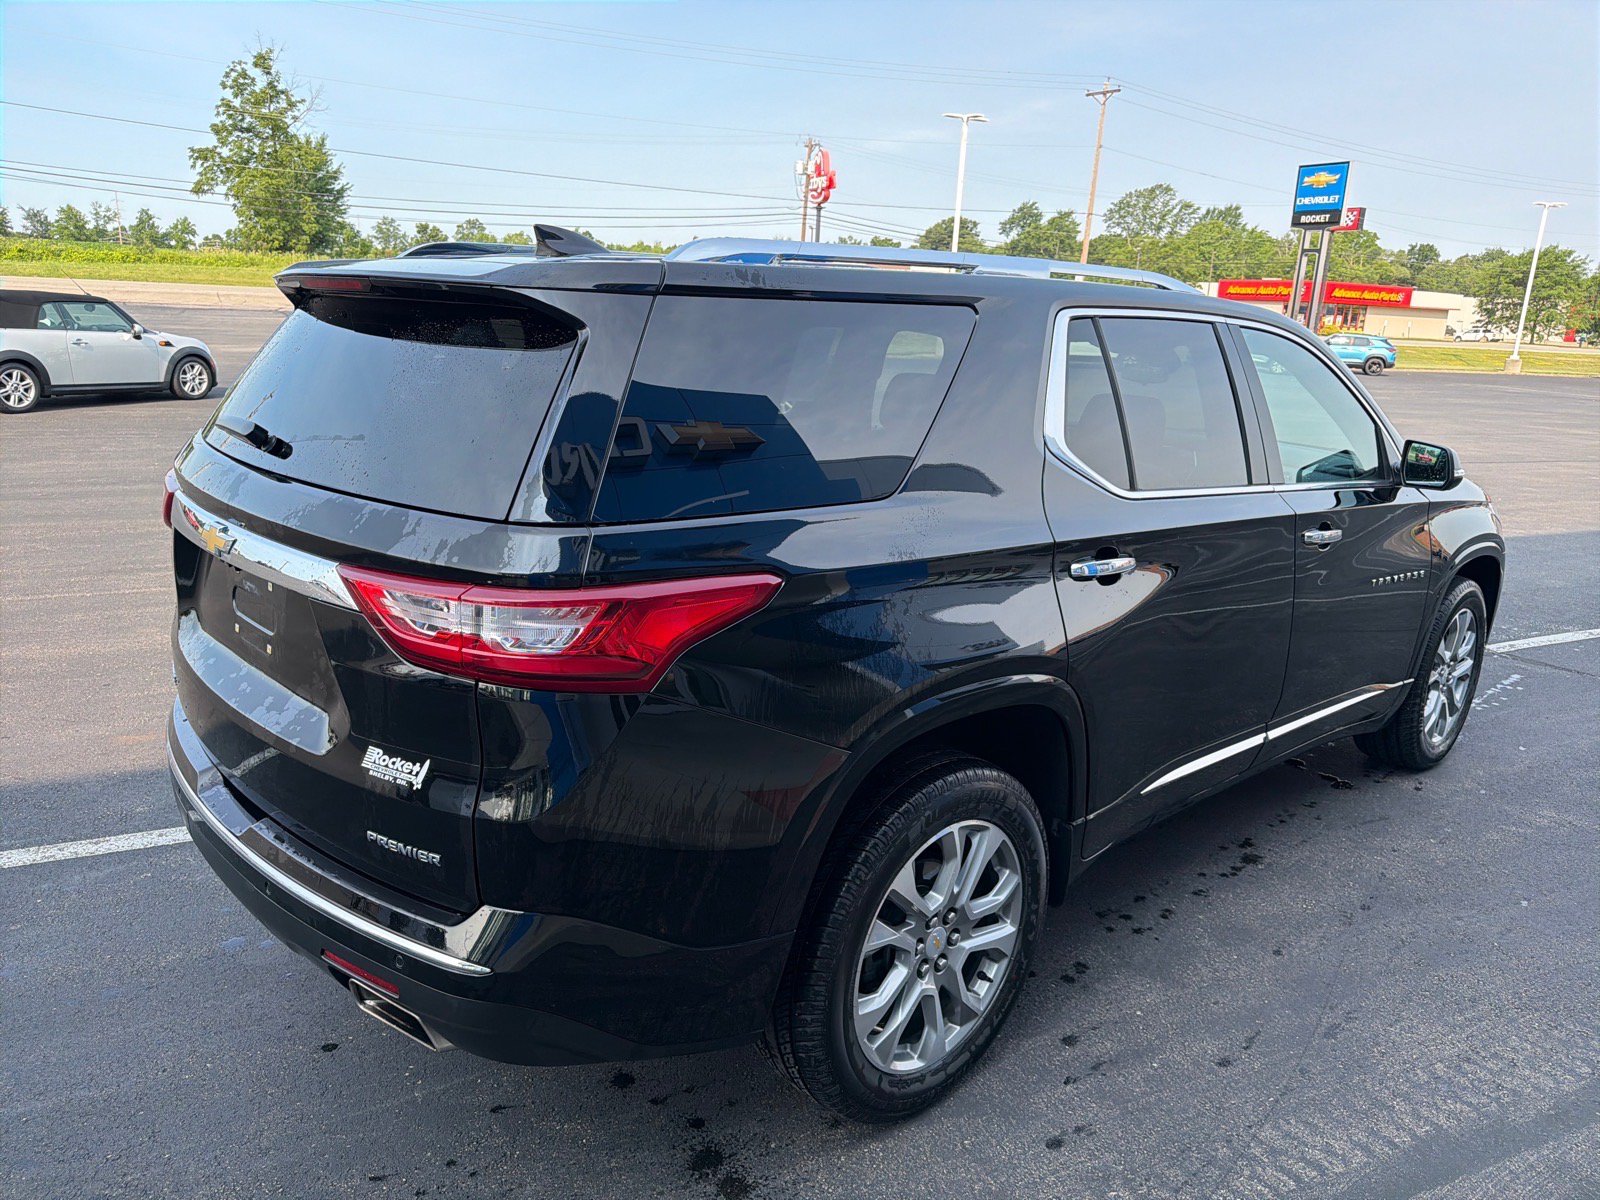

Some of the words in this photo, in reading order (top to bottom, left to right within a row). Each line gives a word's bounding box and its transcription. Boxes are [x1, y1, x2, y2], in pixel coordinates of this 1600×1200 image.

[1296, 195, 1340, 205] CHEVROLET
[1300, 214, 1330, 223] ROCKET
[1227, 286, 1257, 294] Advance
[1257, 286, 1276, 295] Auto
[1331, 288, 1361, 298] Advance
[1362, 290, 1379, 300] Auto
[1371, 570, 1425, 587] TRAVERSE
[364, 745, 421, 775] Rocket
[368, 769, 395, 783] SHELBY,
[366, 830, 441, 867] PREMIER
